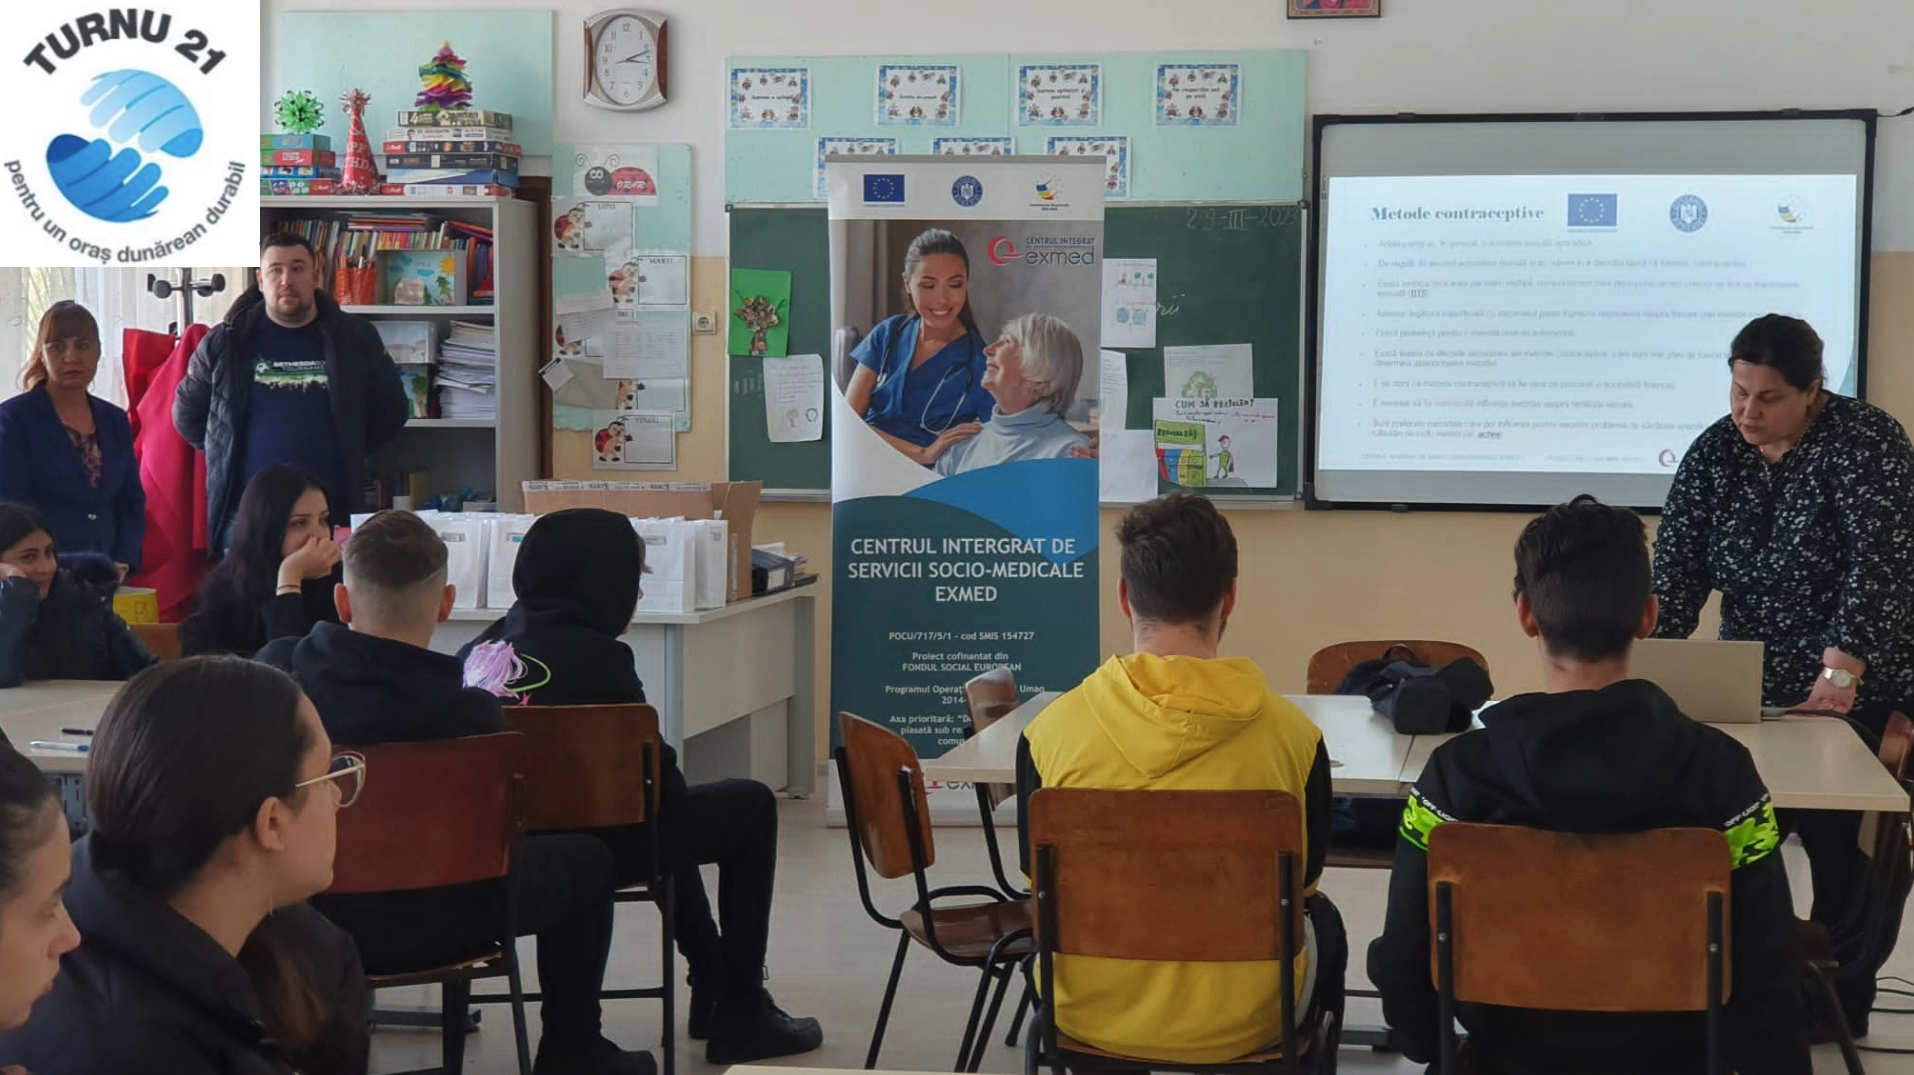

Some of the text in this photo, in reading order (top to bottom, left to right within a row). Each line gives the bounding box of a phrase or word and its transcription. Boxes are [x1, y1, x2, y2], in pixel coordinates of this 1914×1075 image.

[1371, 205, 1545, 222] Metode contraceptive
[1026, 236, 1095, 245] CENTRUL INTEGRAT
[1025, 246, 1095, 266] exmed
[850, 537, 1076, 555] CENTRUL INTERGRAT DE
[847, 562, 1085, 579] SERVICII SOCIO-MEDICALE
[935, 586, 998, 602] EXMED
[889, 631, 952, 642] POCU/717/5/1
[960, 631, 977, 642] cod
[979, 631, 999, 641] SMIS
[1001, 631, 1035, 641] 154727
[912, 651, 945, 662] Proiect
[993, 651, 1009, 661] din
[902, 663, 938, 672] FONDUL
[940, 663, 972, 672] SOCIAL
[885, 685, 931, 695] Programul
[942, 696, 967, 705] 2014-
[890, 714, 908, 723] Axa
[909, 714, 955, 725] prioritară:
[900, 725, 933, 736] plasată
[935, 725, 952, 734] sub
